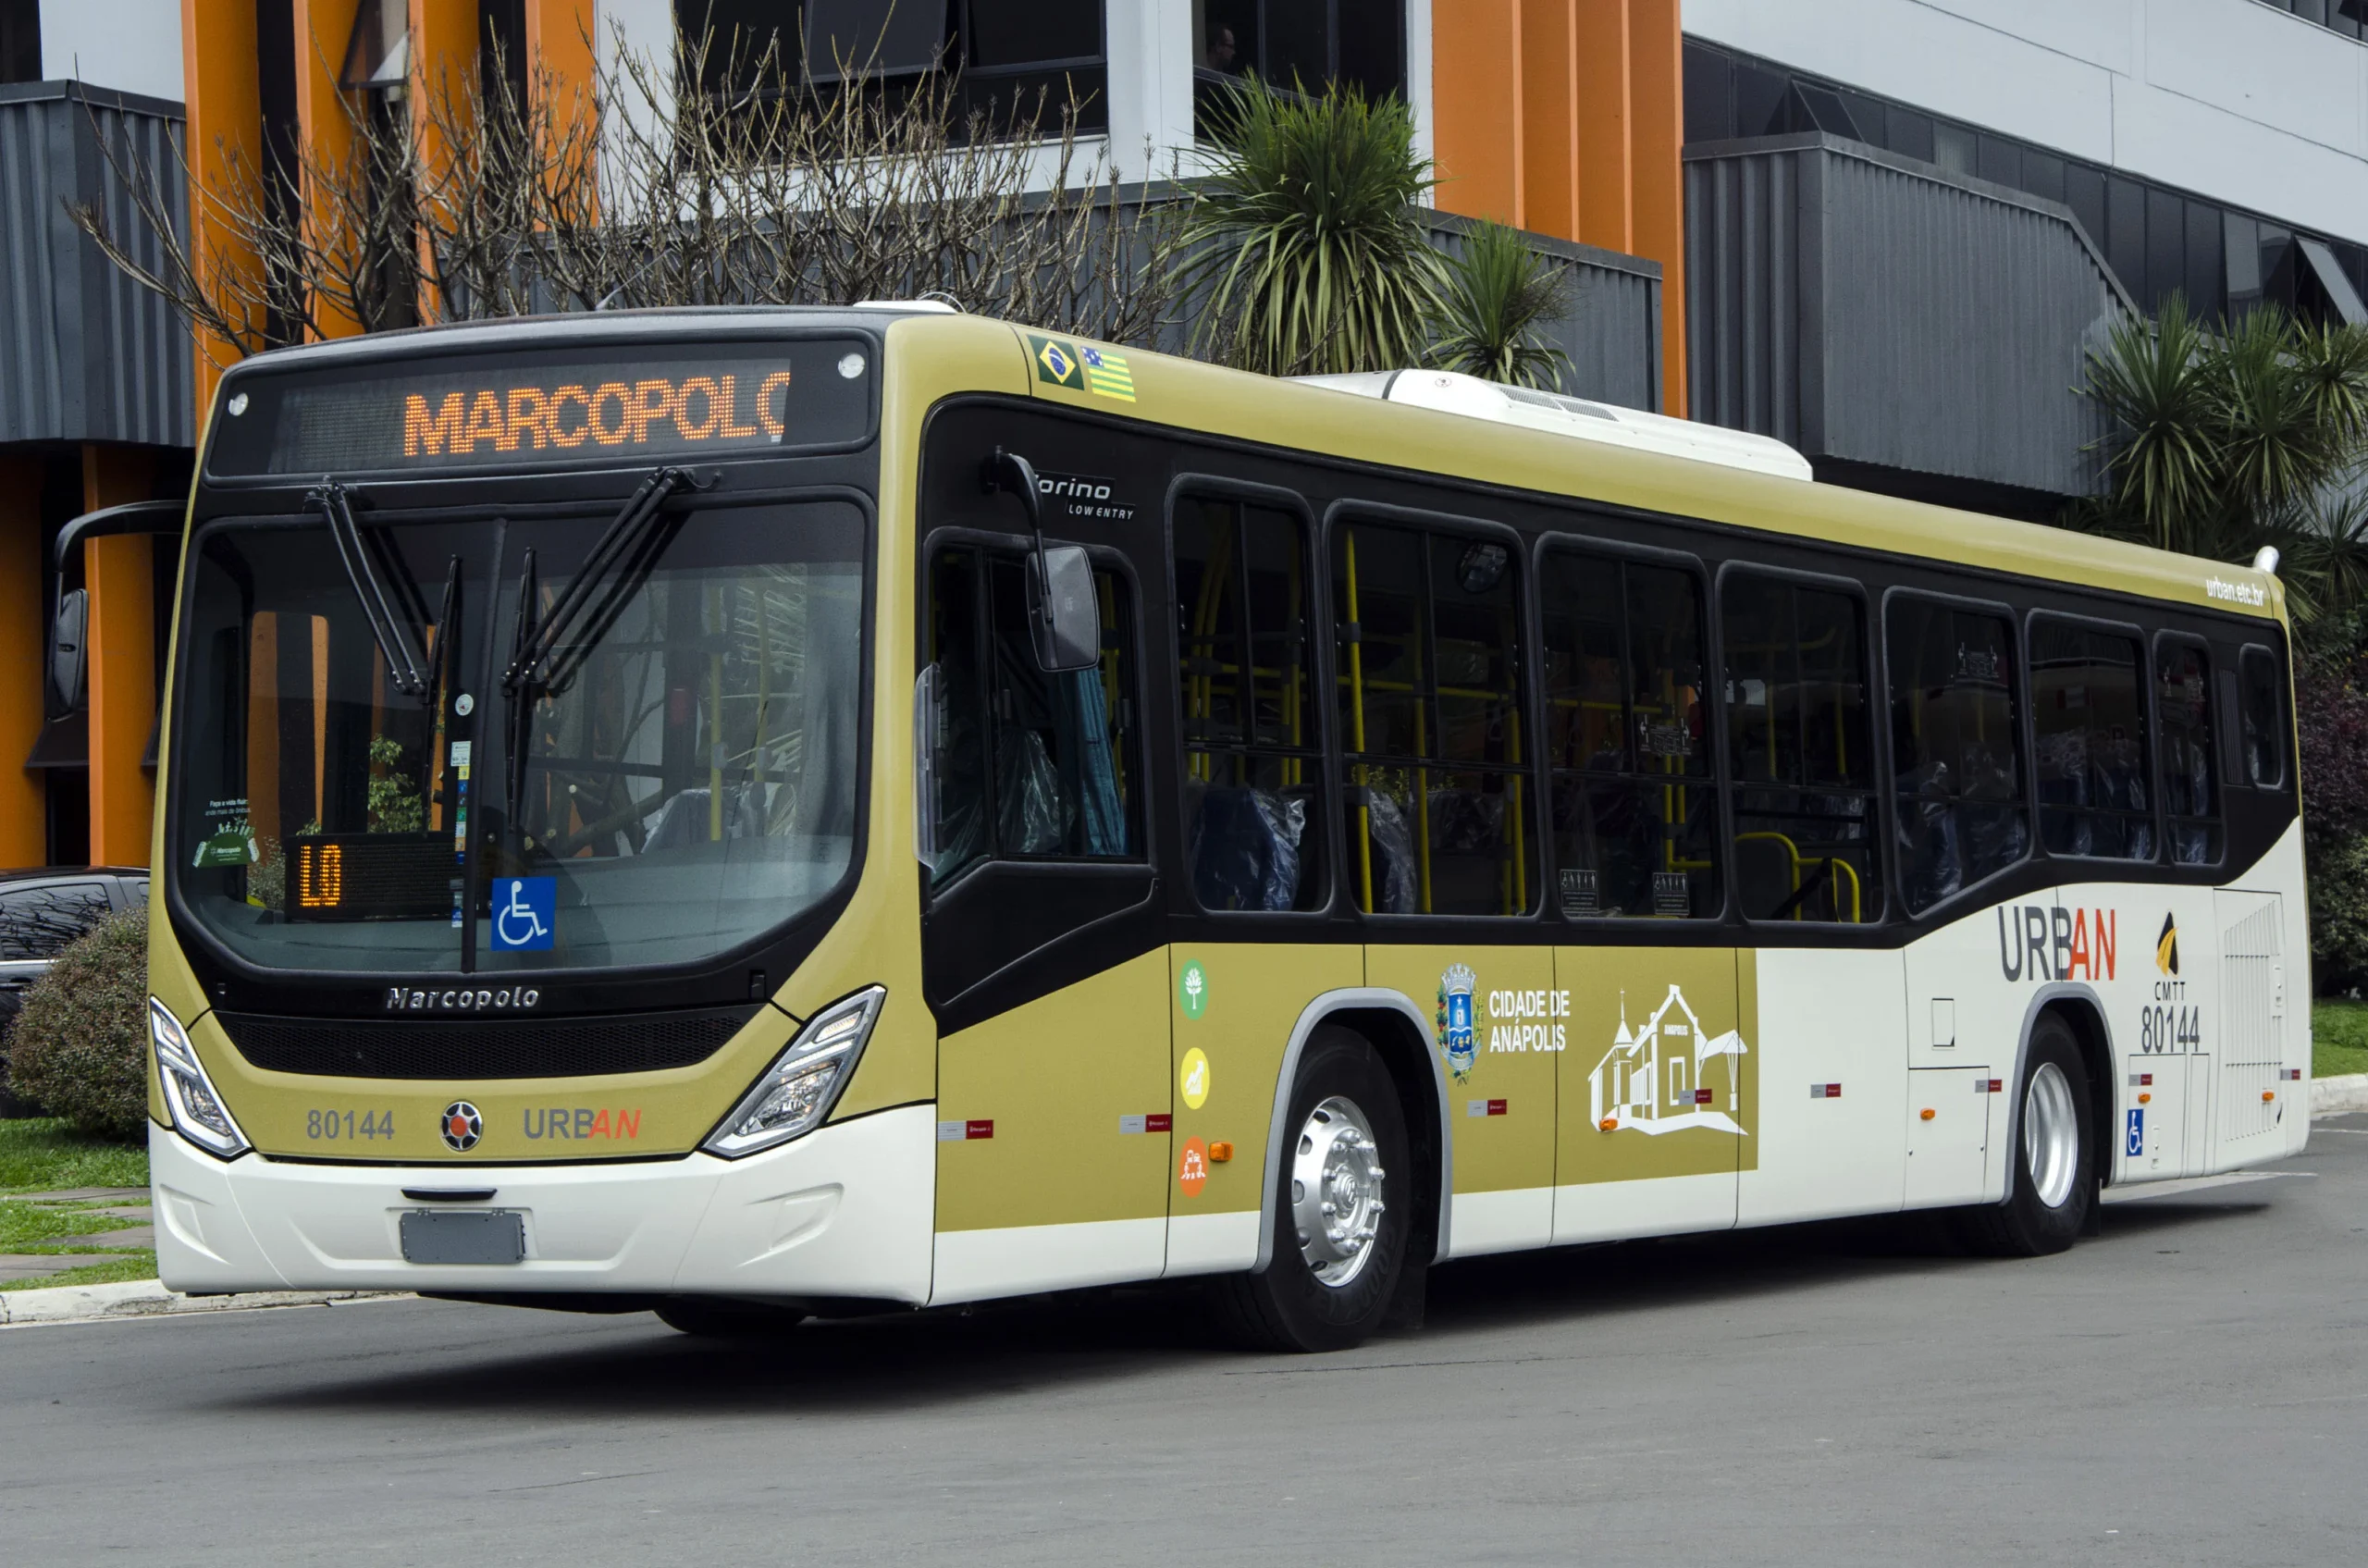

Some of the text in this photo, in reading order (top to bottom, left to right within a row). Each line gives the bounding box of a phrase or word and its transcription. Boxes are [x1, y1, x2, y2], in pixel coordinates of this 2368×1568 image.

[1035, 474, 1111, 500] orino
[1068, 504, 1134, 520] LOW ENTRY
[2205, 575, 2264, 607] urban.etc.br
[1998, 906, 2115, 982] URBAN
[387, 986, 539, 1011] Marcopolo
[1489, 990, 1571, 1018] CIDADE DE
[2154, 982, 2186, 1001] CMTT
[1489, 1018, 1566, 1053] ANÁPOLIS
[2141, 1006, 2200, 1054] 80144
[306, 1109, 395, 1141] 80144
[524, 1108, 642, 1140] URBAN
